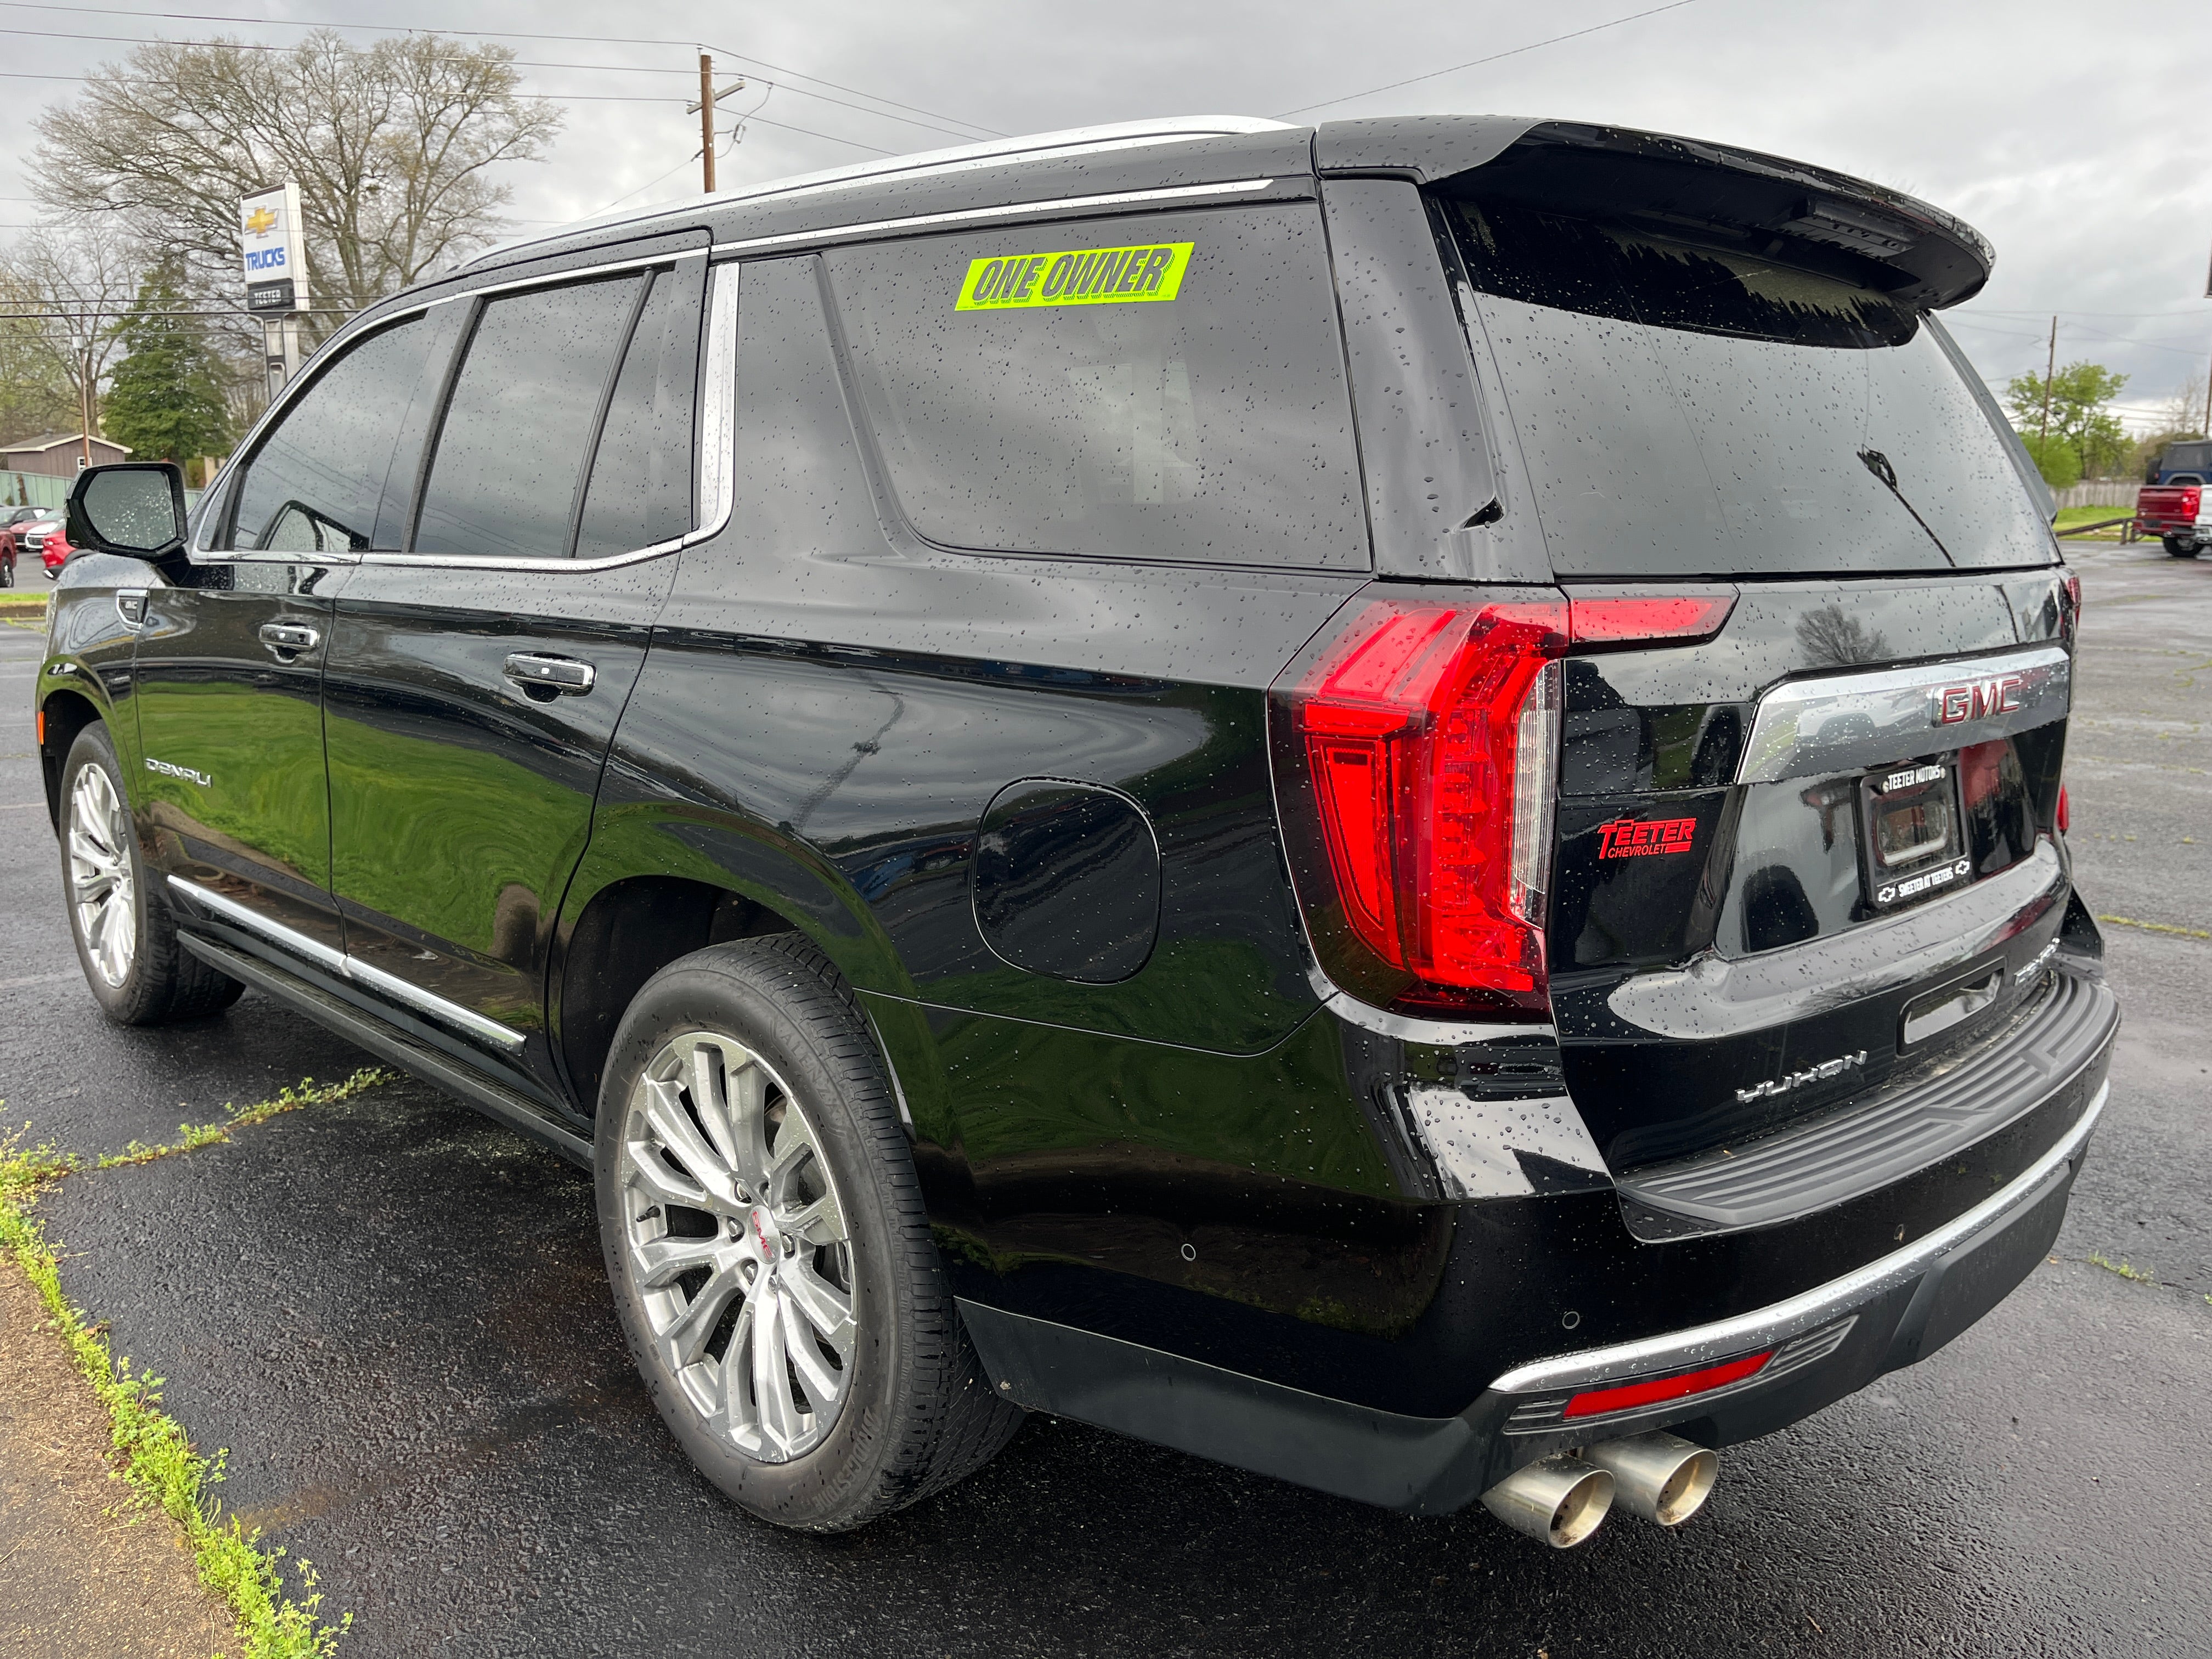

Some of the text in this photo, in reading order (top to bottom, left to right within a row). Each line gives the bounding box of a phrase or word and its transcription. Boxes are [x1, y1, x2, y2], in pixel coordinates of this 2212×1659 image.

[246, 247, 285, 270] TRUCKS
[972, 247, 1176, 306] ONE OWNER
[254, 289, 281, 306] TEETER
[1933, 675, 2023, 727] GMC
[145, 758, 212, 788] DENALI
[1888, 765, 1940, 791] TEETER MOTORS
[1598, 821, 1696, 859] TEETER
[1608, 844, 1665, 858] CHEVROLET
[780, 1032, 843, 1121] ALENZA
[1734, 1050, 1867, 1104] YUKON
[752, 1211, 775, 1260] GMC
[811, 1405, 883, 1513] BRIDGESTONE
